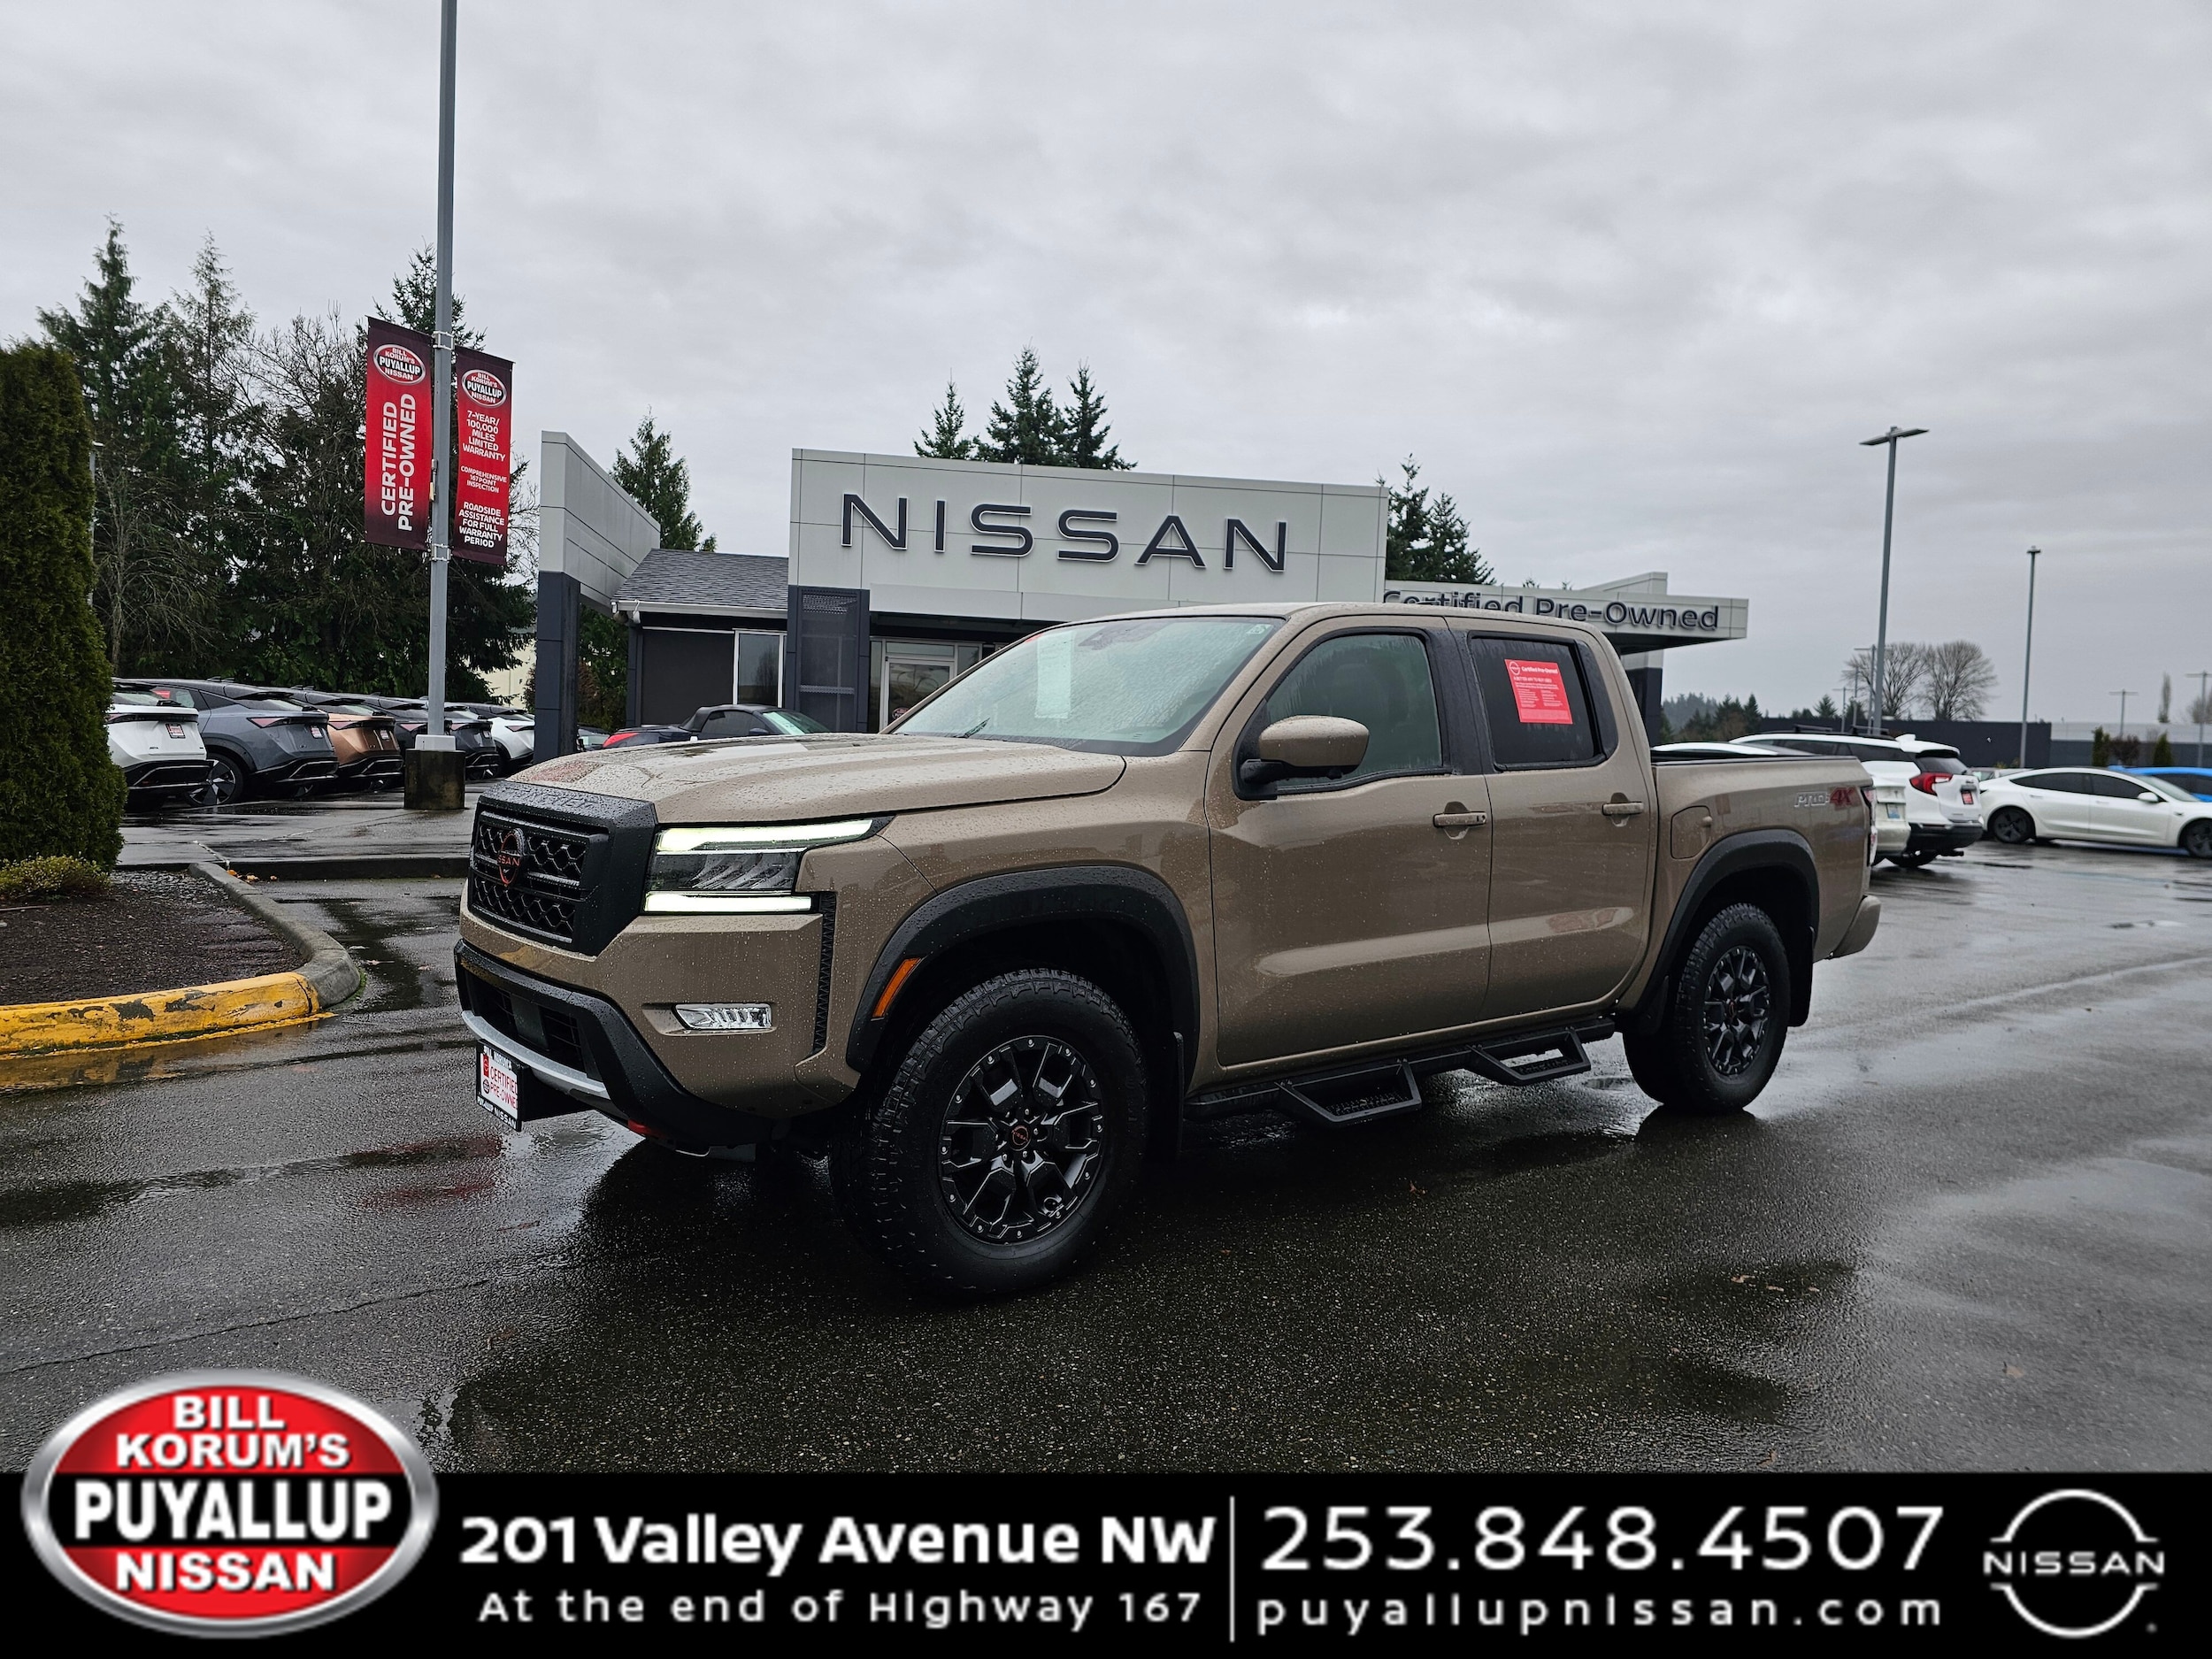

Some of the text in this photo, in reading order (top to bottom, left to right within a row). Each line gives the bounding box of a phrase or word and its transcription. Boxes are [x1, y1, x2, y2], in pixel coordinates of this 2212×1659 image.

[385, 350, 415, 364] KORUM'S
[380, 357, 420, 374] PUYALLUP
[385, 368, 413, 380] NISSAN
[467, 381, 502, 398] PUYALLUP
[471, 376, 497, 388] KORUM'S
[471, 392, 495, 403] NISSAN
[467, 410, 500, 426] 7-YEAR/
[466, 419, 498, 434] 100,000
[472, 429, 495, 442] MILES
[468, 436, 498, 451] LIMITED
[381, 401, 397, 516] CERTIFIED
[462, 442, 505, 461] WARRANTY
[398, 393, 416, 531] PRE-OWNED
[460, 465, 507, 482] COMPREHENSIVE
[466, 480, 499, 493] INSPECTION
[478, 477, 496, 487] POINT
[464, 501, 501, 517] ROADSIDE
[458, 509, 504, 526] ASSISTANCE
[462, 518, 498, 533] FOR FULL
[841, 494, 1286, 572] NISSAN
[458, 526, 503, 541] WARRANTY
[464, 535, 495, 548] PERIOD
[1536, 598, 1719, 630] Pre-Owned
[497, 854, 520, 866] SSAN
[489, 1081, 518, 1109] PRE-OWNE
[494, 1107, 517, 1130] NISSAN
